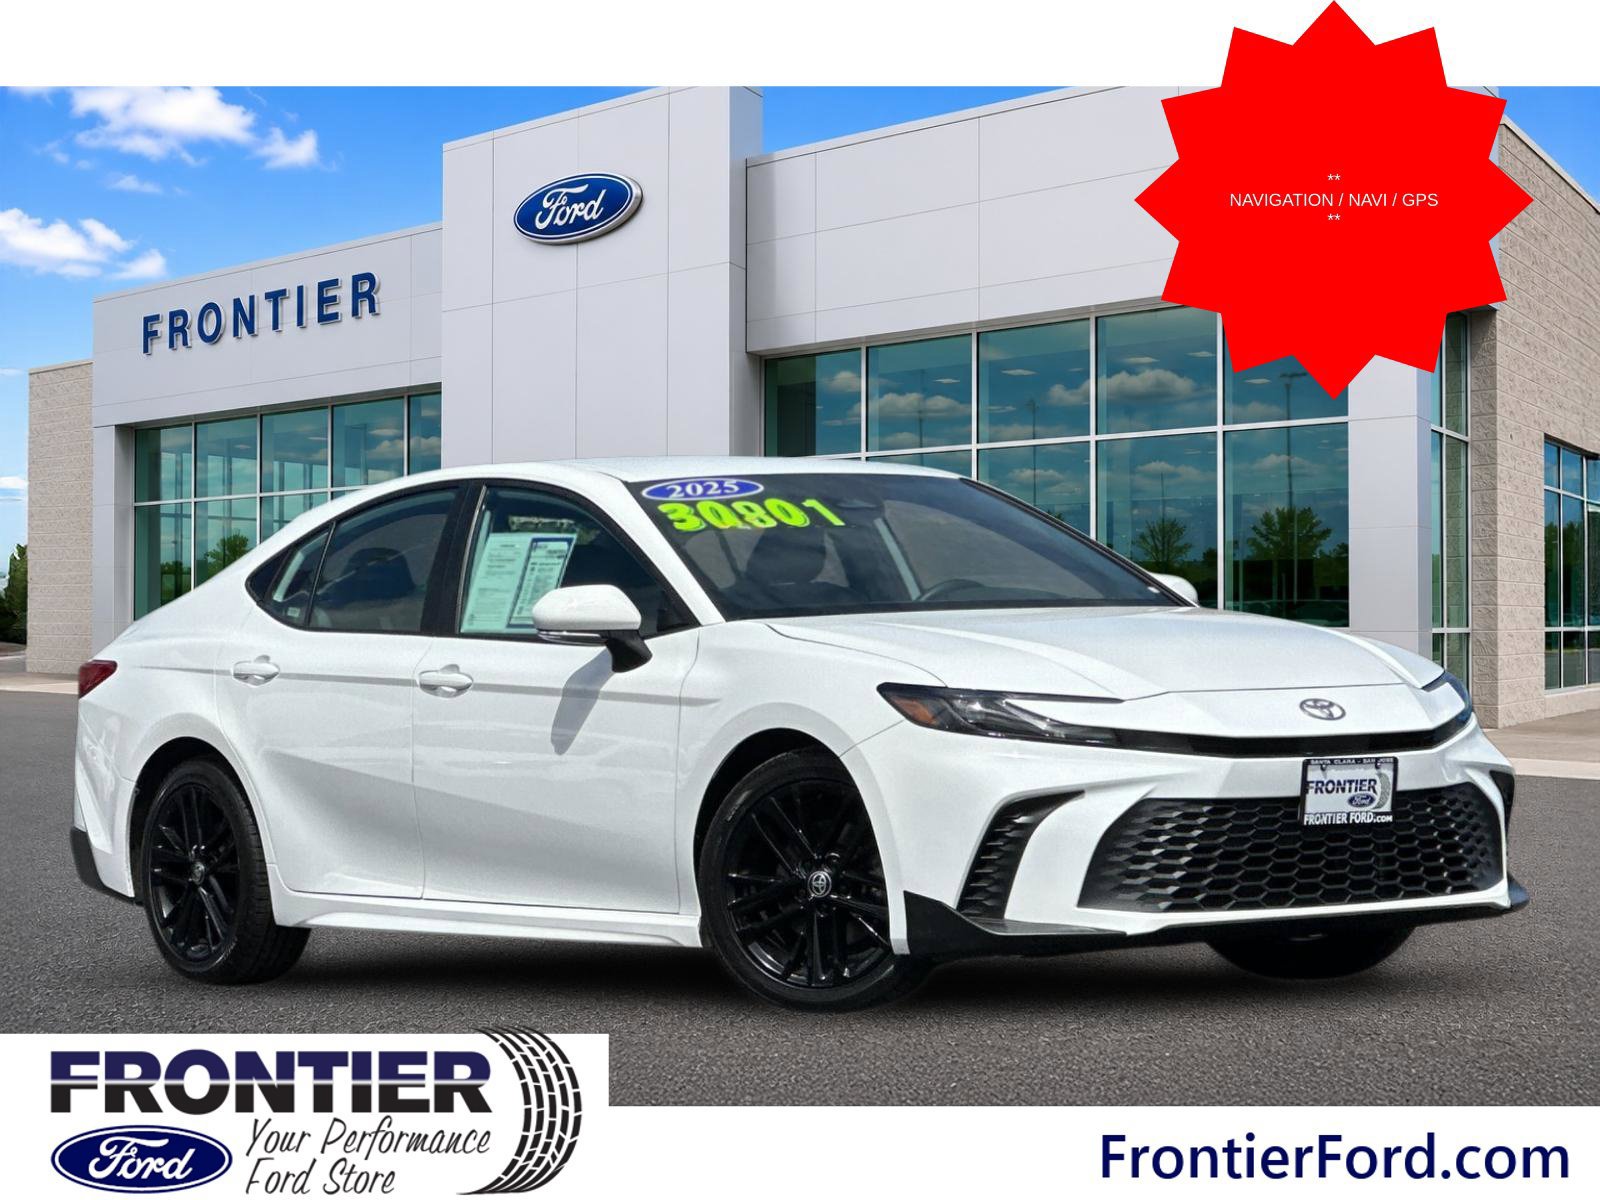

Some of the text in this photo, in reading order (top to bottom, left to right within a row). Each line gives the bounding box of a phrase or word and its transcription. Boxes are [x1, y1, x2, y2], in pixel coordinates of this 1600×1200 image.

[535, 184, 607, 229] Ford
[142, 272, 379, 355] FRONTIER
[666, 481, 740, 499] 2025
[657, 497, 846, 532] 30801
[1306, 779, 1378, 795] FRONTIER
[1303, 813, 1348, 826] FRONTIER
